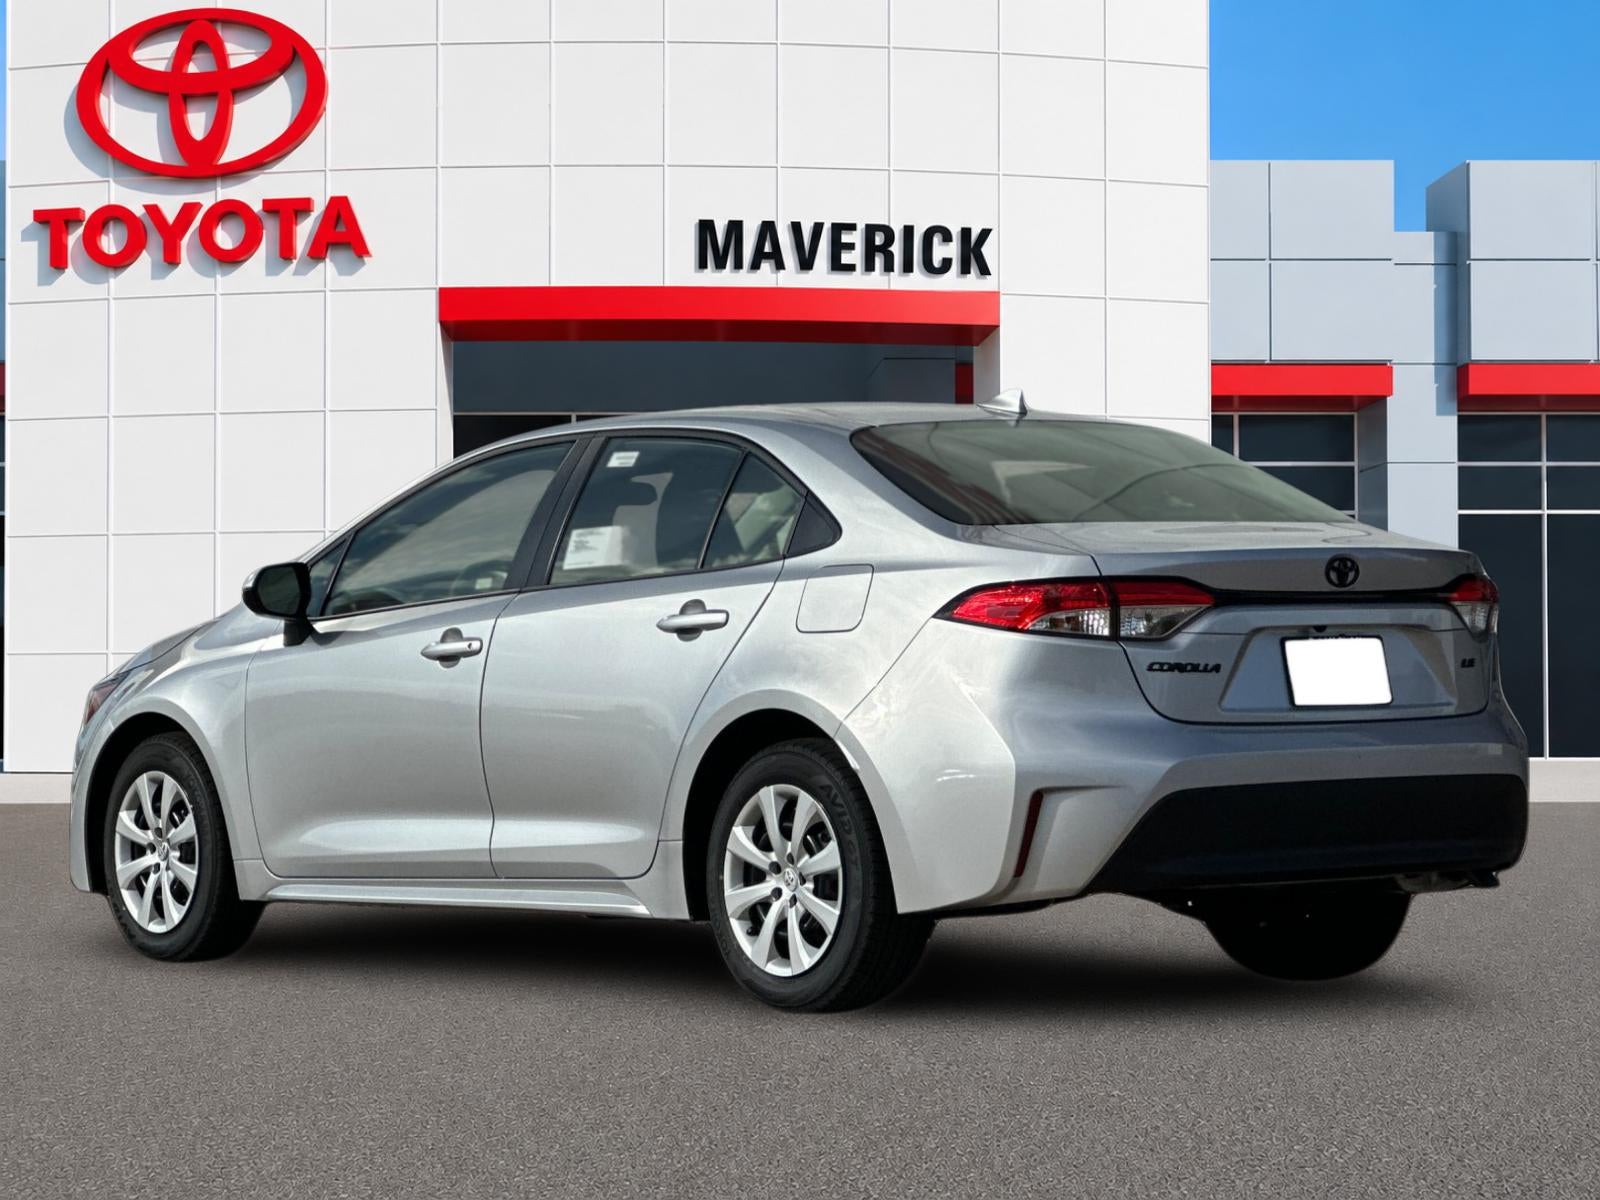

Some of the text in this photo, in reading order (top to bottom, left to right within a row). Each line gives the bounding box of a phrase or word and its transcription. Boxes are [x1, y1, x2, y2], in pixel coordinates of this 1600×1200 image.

[33, 196, 372, 270] TOYOTA
[697, 219, 993, 276] MAVERICK
[1147, 662, 1221, 673] COROLLA
[1460, 658, 1476, 668] LE
